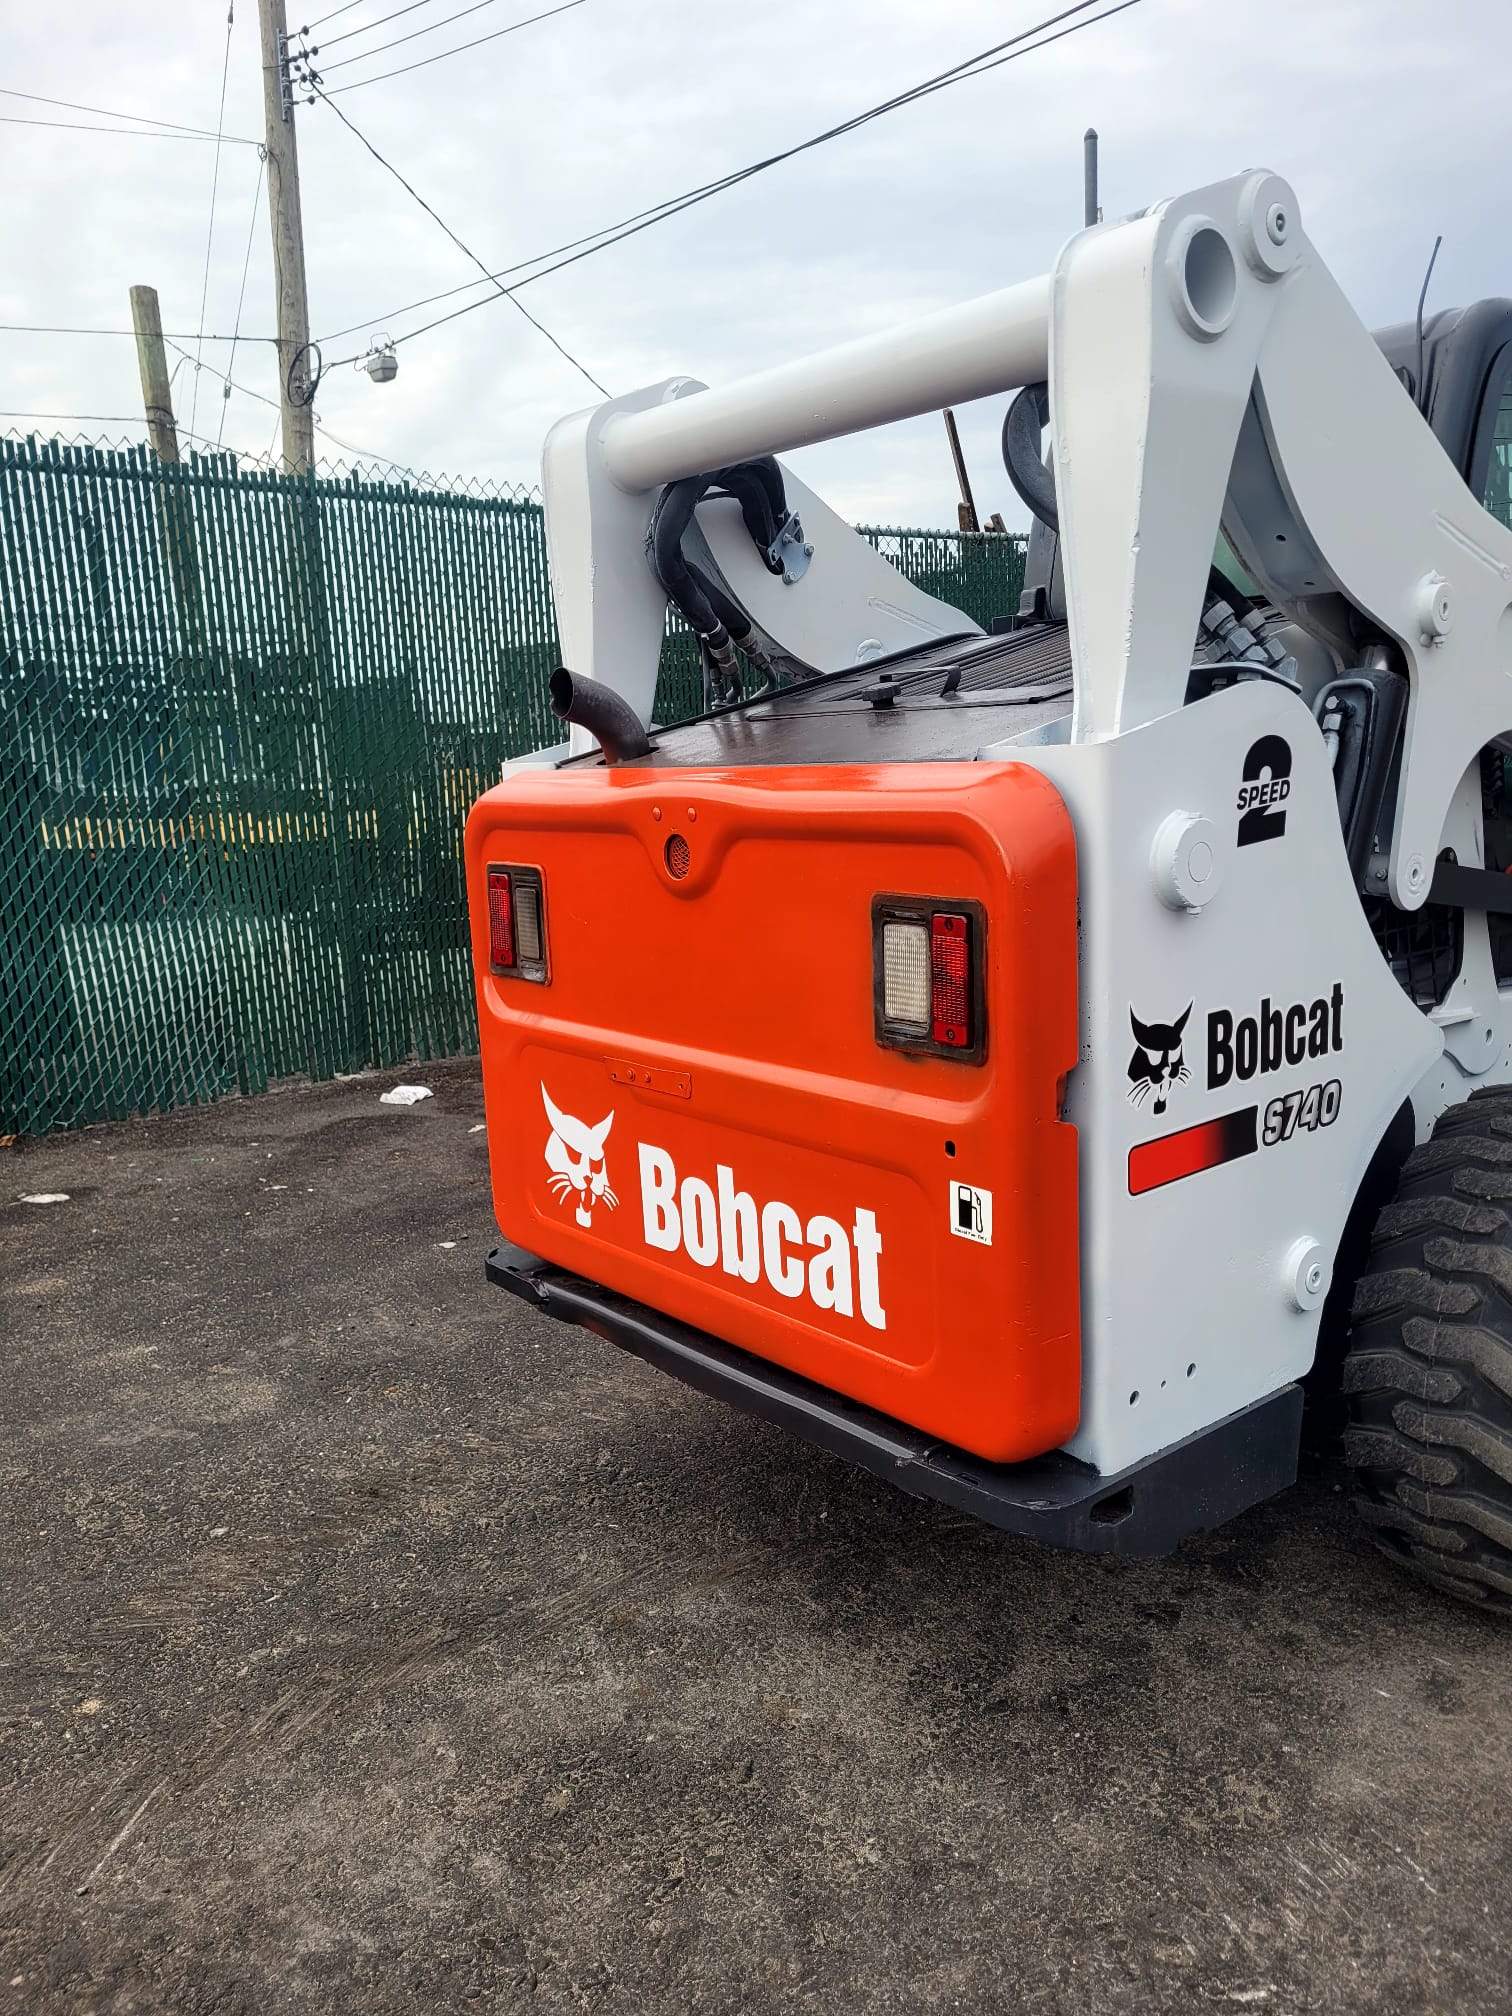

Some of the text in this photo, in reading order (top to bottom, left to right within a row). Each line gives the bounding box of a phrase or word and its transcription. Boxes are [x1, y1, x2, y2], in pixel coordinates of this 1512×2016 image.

[1236, 779, 1291, 811] SPEED
[1237, 734, 1292, 848] 2
[1207, 982, 1344, 1091] Bobcat
[1262, 1078, 1342, 1147] S740
[637, 1141, 887, 1330] Bobcat
